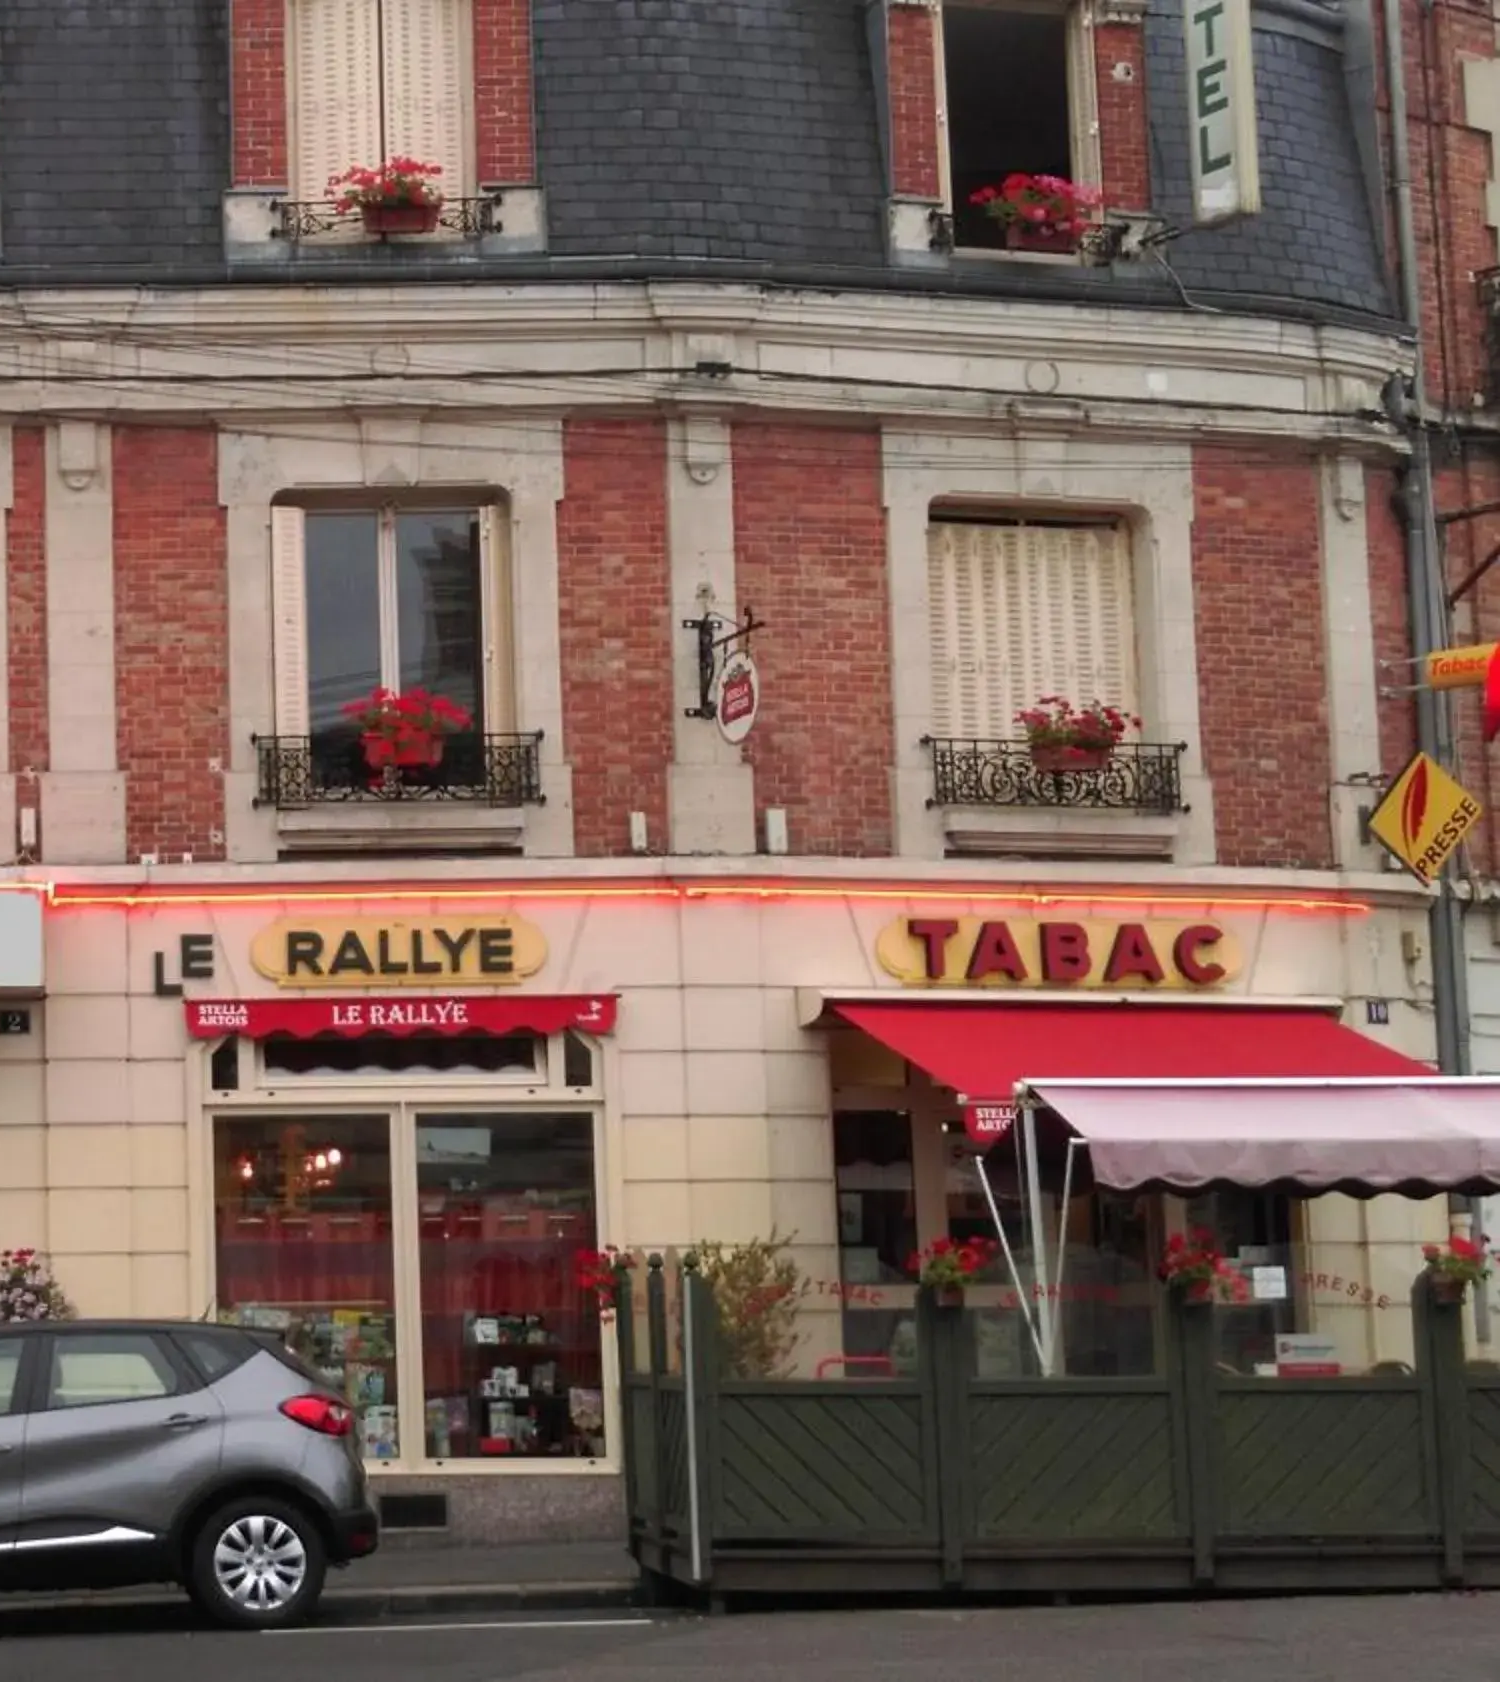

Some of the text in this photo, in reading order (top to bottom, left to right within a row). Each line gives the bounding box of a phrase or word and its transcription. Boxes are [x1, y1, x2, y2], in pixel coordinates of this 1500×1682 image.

[1414, 797, 1479, 877] PRESSE
[154, 927, 514, 996] LE RALLYE
[907, 919, 1229, 984] TABAC
[198, 1004, 248, 1015] STELLA
[198, 1015, 248, 1026] ARTOIS
[332, 1001, 469, 1025] LE RALLYE
[7, 1014, 22, 1031] 2
